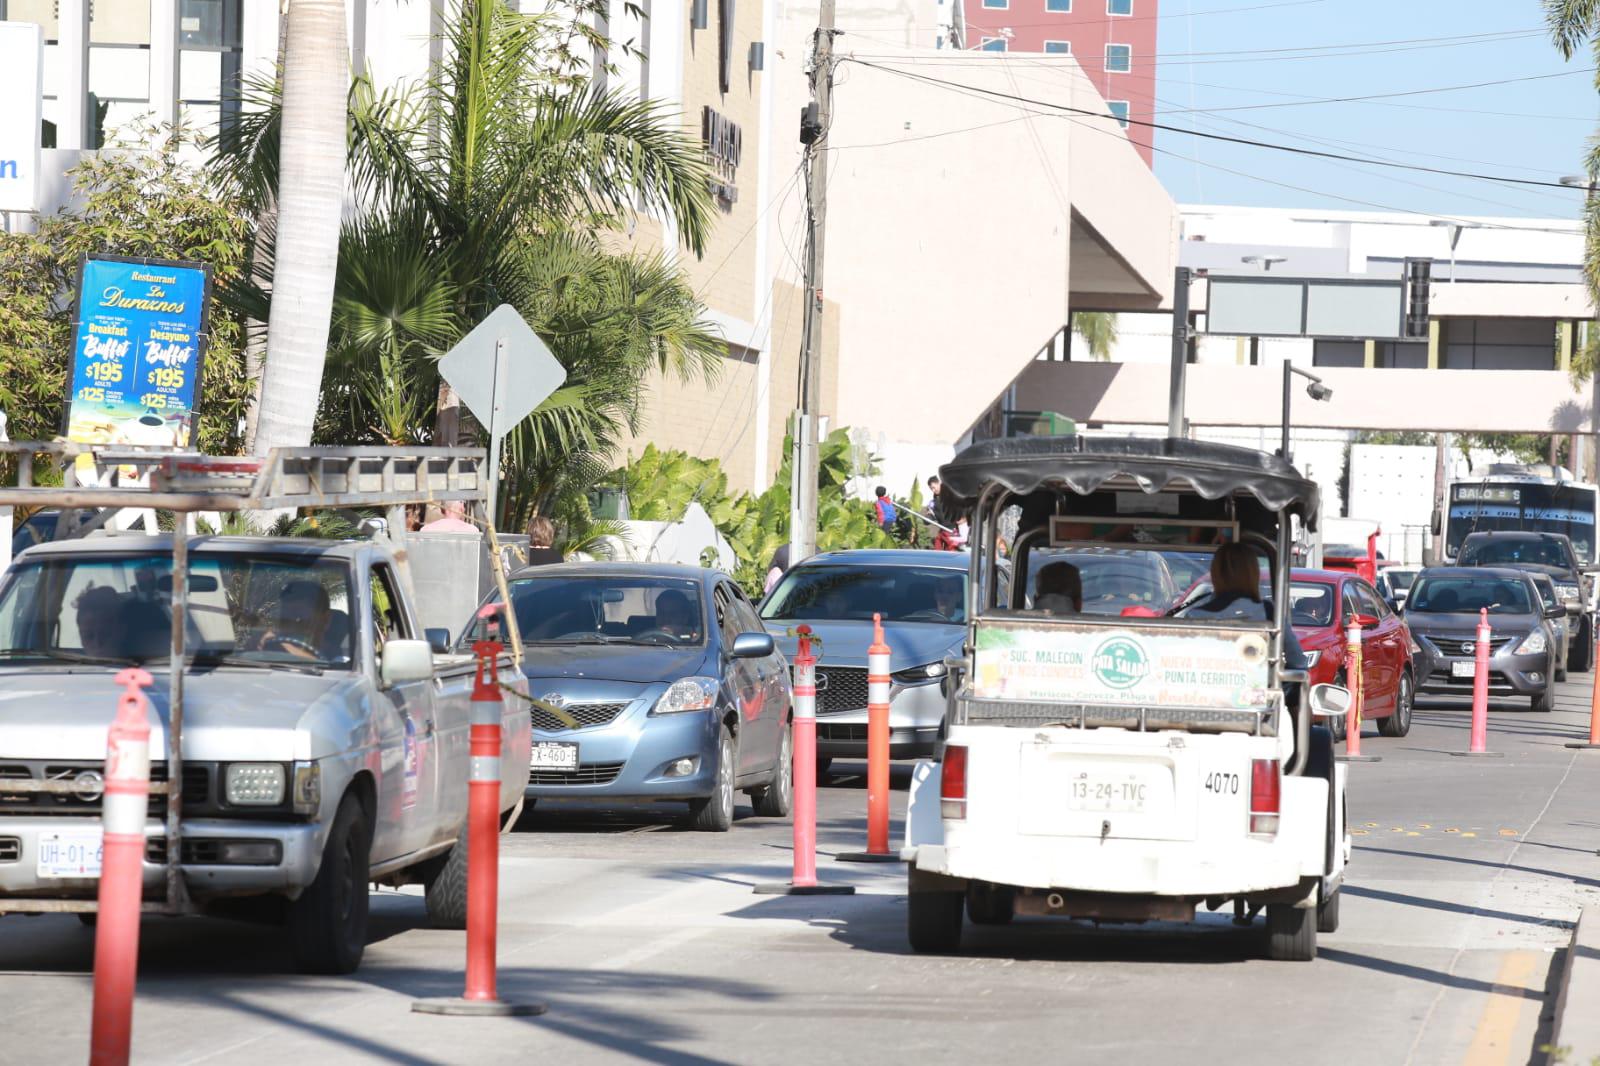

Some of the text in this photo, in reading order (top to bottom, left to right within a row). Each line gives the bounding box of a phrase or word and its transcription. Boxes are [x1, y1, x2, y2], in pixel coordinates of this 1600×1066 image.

[131, 271, 177, 285] Restaurant
[99, 286, 185, 313] Duraznos
[88, 323, 128, 336] Breakfast
[150, 329, 190, 343] Desayuno
[82, 334, 132, 360] Buffet
[144, 340, 194, 367] Buffet
[85, 361, 123, 382] $195
[147, 368, 185, 388] $195
[78, 387, 105, 402] $125
[140, 393, 167, 408] $125
[1010, 650, 1083, 665] SUC. MALECON
[1165, 671, 1247, 686] PUNTA CERRITOS
[1072, 782, 1147, 801] 13-24-TVC
[1205, 772, 1239, 795] 4070
